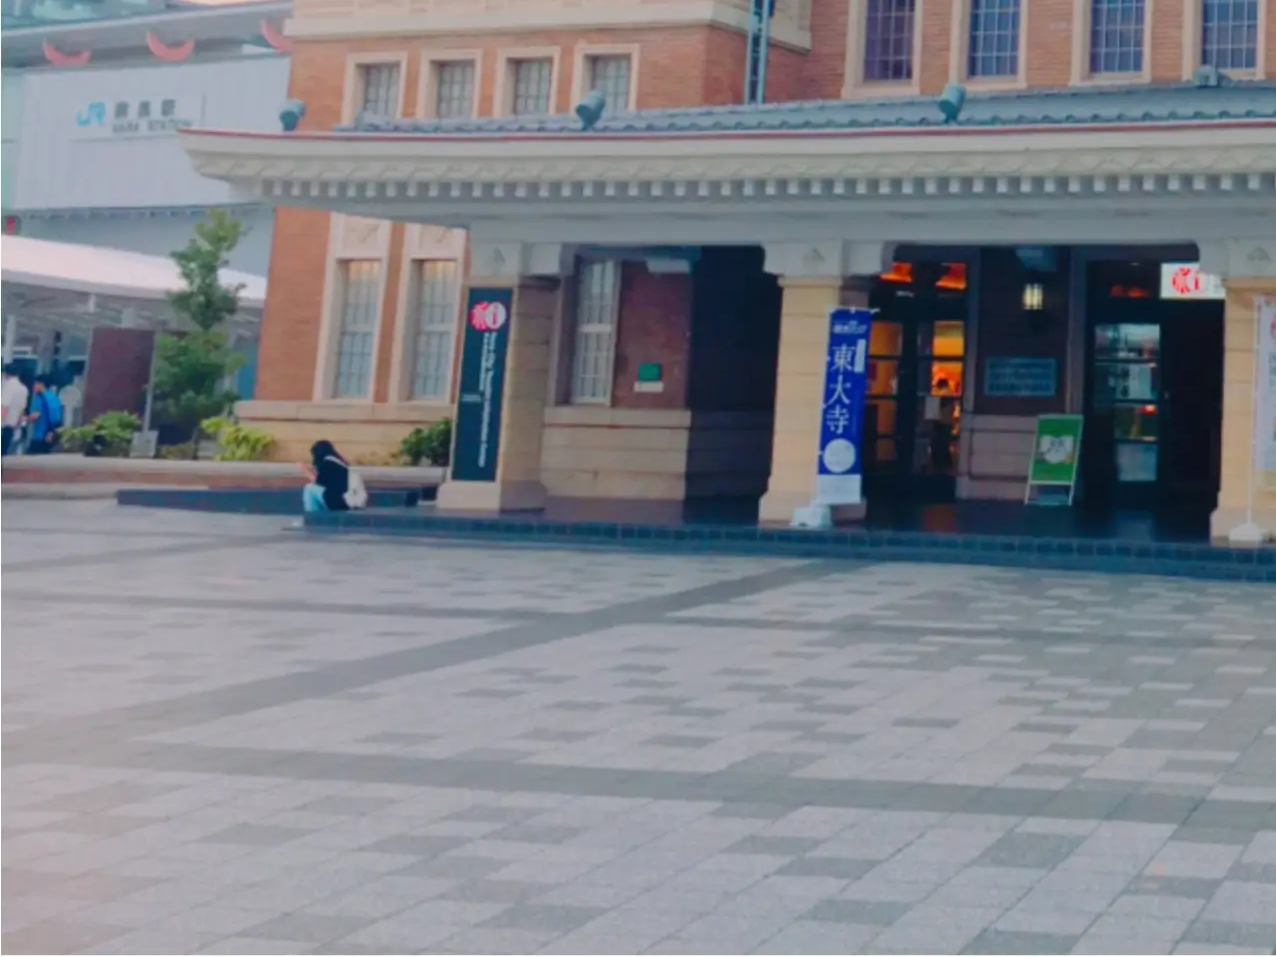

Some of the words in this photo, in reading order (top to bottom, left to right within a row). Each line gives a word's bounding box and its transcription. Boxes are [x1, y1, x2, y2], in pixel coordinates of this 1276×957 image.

[76, 101, 105, 127] JR
[827, 344, 856, 434] 東大寺
